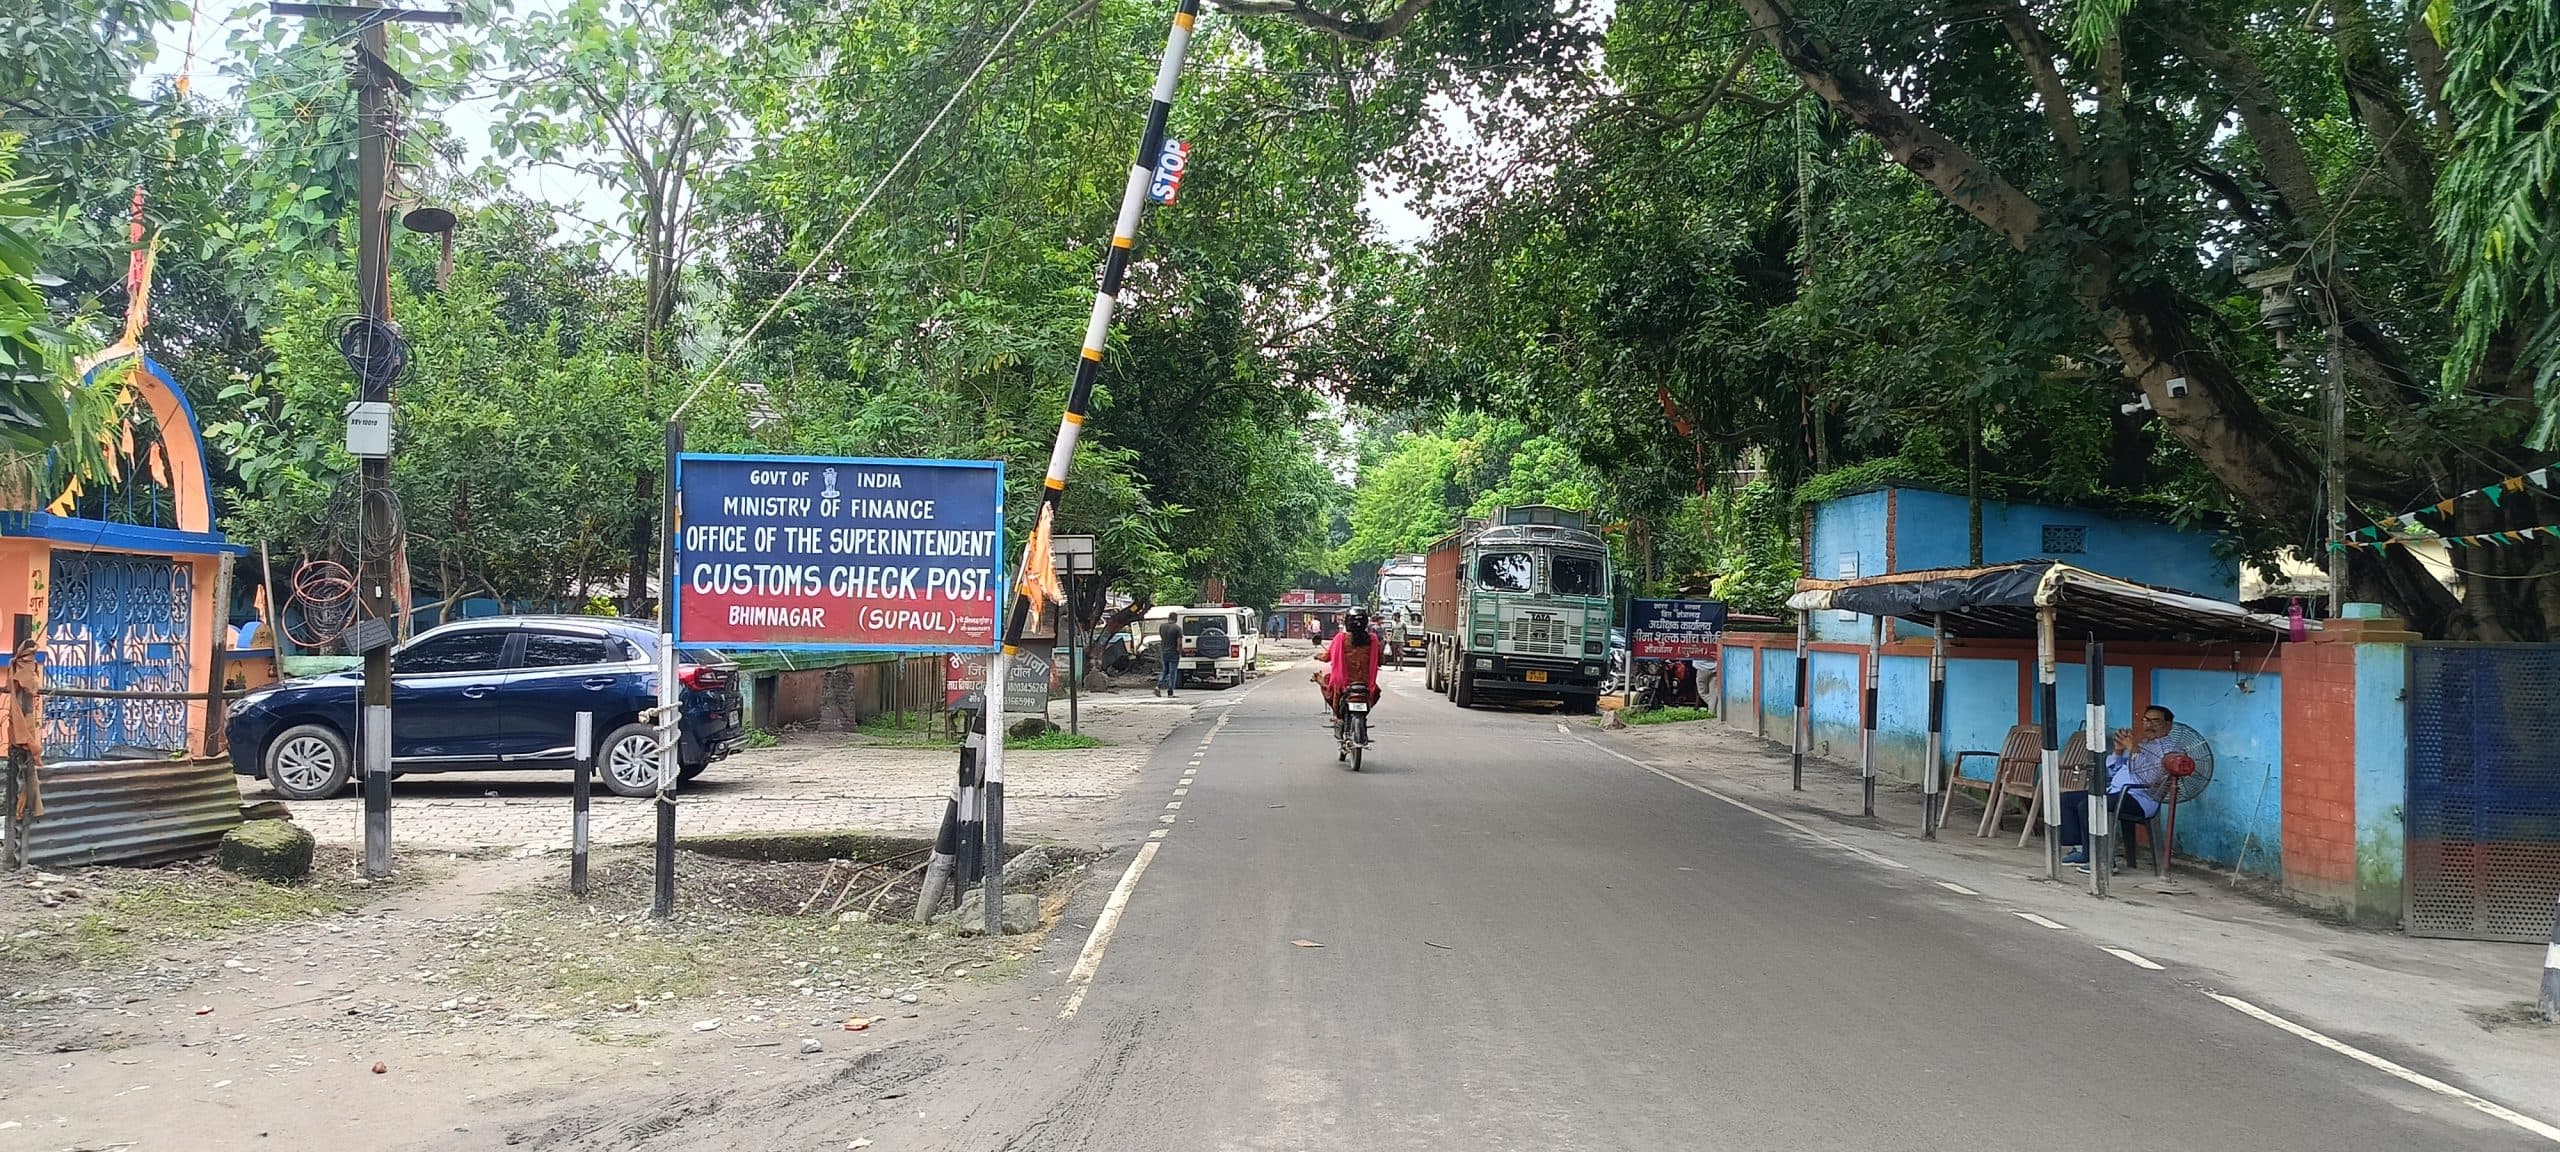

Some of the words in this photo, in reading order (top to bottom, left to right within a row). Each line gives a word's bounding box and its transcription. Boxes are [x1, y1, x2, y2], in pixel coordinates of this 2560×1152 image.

[1152, 139, 1187, 200] STOP
[750, 470, 786, 486] GOVT
[792, 471, 809, 486] OF
[857, 472, 902, 489] INDIA
[724, 496, 810, 517] MINISTRY
[820, 498, 841, 518] OF
[851, 499, 935, 520] FINANCE
[686, 525, 747, 552] OFFICE
[754, 526, 777, 552] OF
[784, 527, 823, 554] THE
[830, 528, 996, 558] SUPERINTENDENT
[692, 563, 822, 597] CUSTOMS
[829, 565, 920, 600] CHECK
[926, 567, 992, 601] POST.
[728, 605, 825, 628] BHIMNAGAR
[858, 606, 956, 634] (SUPAUL)
[1531, 614, 1551, 622] TATA
